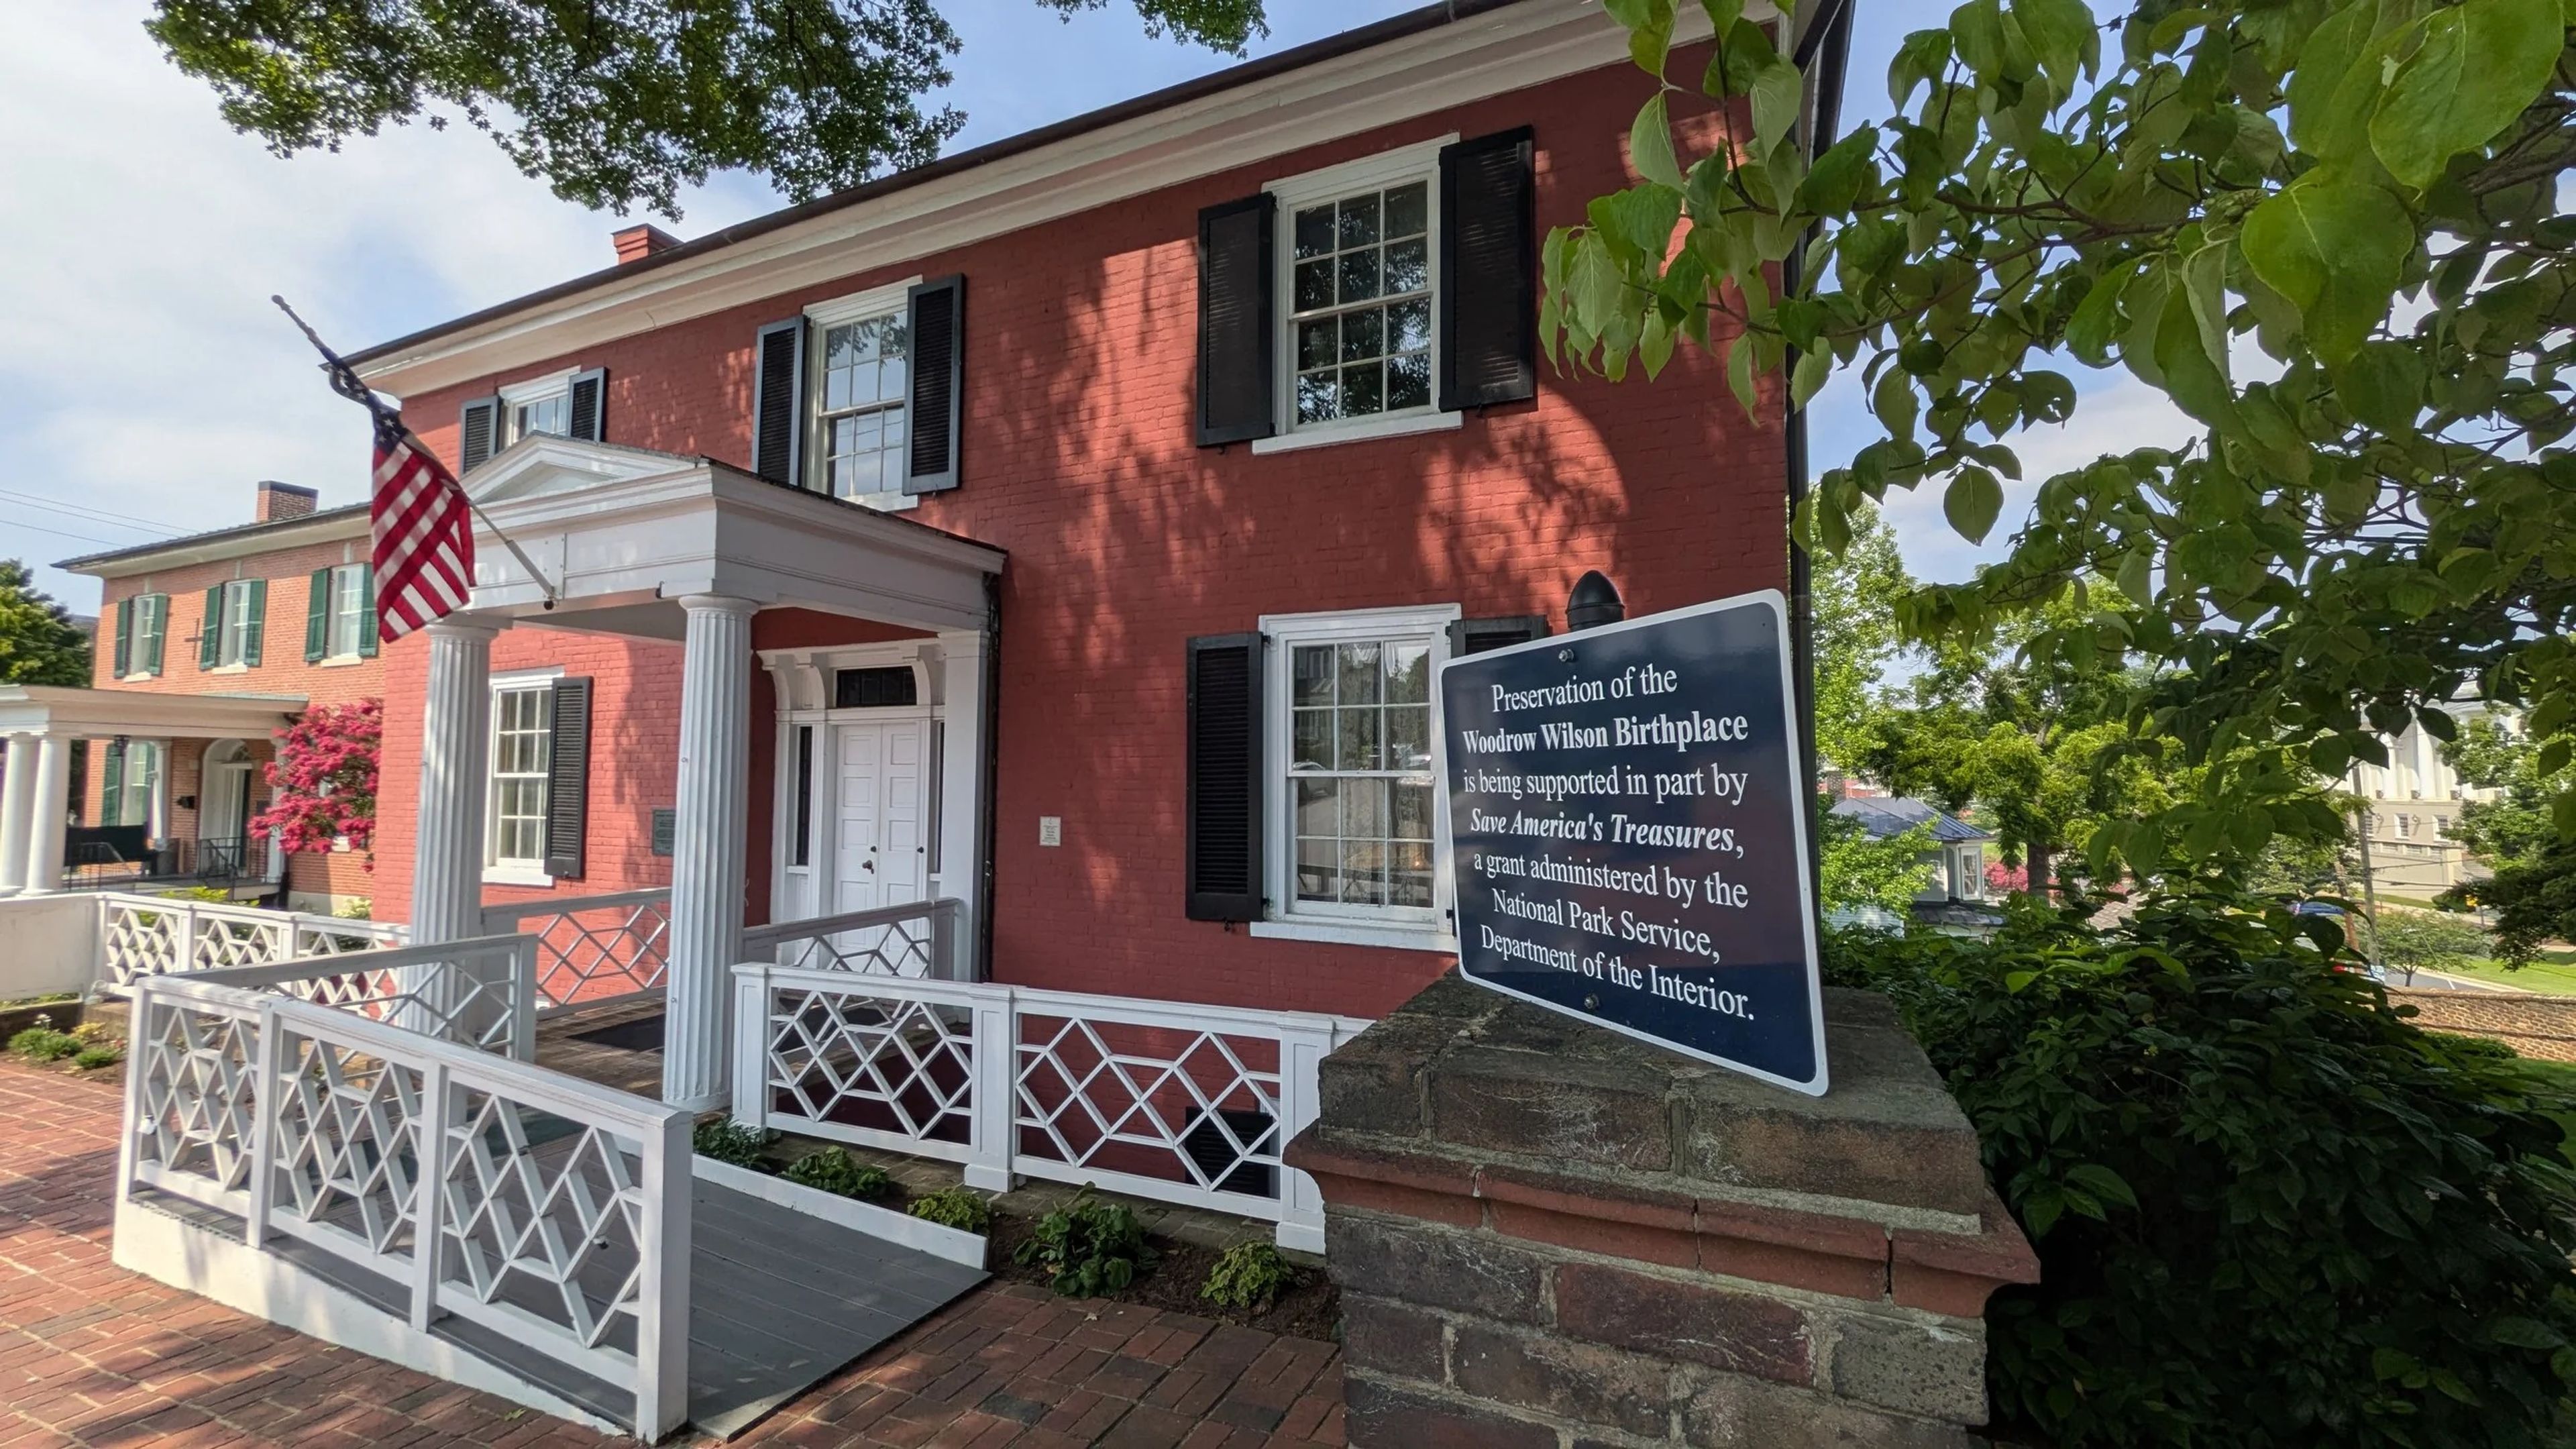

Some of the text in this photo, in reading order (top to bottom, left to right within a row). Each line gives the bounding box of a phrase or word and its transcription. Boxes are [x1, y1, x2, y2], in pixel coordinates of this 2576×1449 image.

[1491, 663, 1678, 712] Preservation of the
[1462, 710, 1749, 754] Woodrow Wilson Birthplace
[1463, 762, 1749, 806] is being supported in part by
[1470, 808, 1744, 859] Save America's Treasures,
[1473, 853, 1749, 909] a grant administered by the
[1491, 888, 1720, 965] National Park Service,
[1480, 924, 1755, 1021] Department of the Interior.
